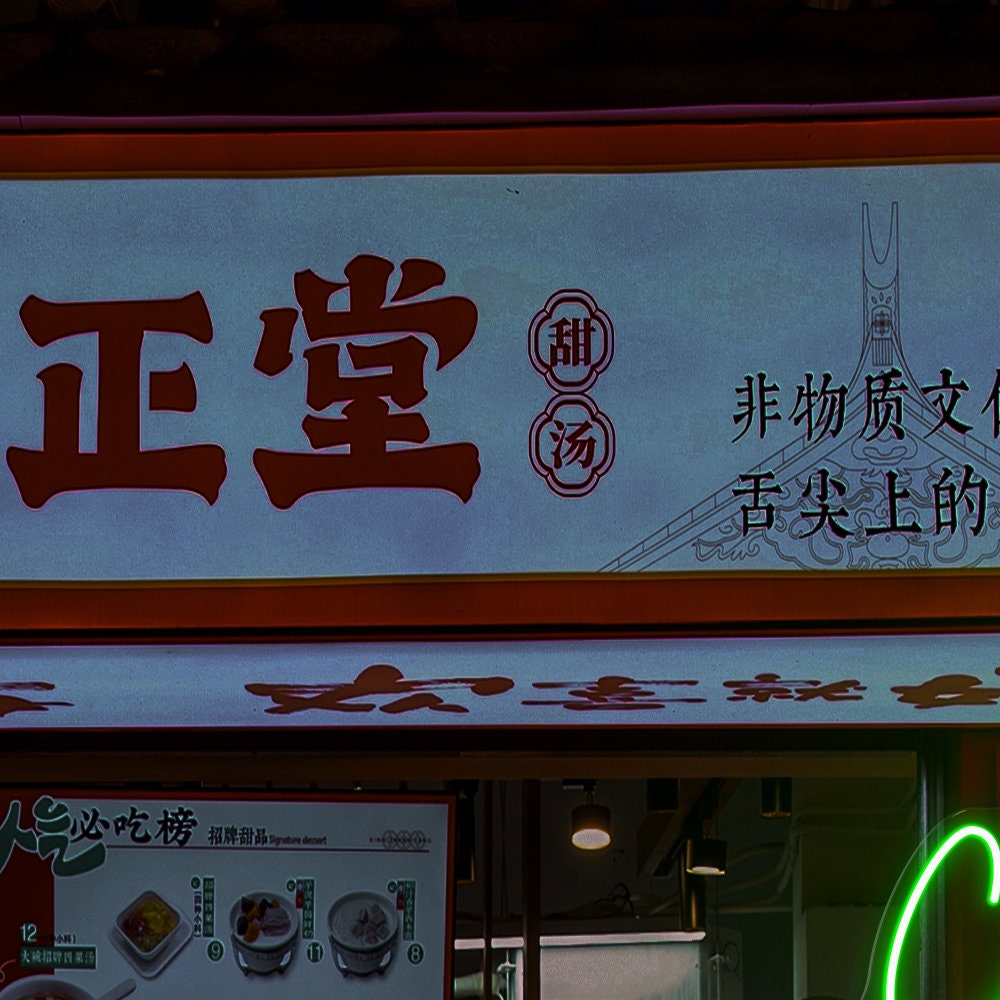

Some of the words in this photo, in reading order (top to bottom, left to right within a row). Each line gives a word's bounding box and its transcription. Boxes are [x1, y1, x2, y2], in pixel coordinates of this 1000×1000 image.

[6, 254, 481, 510] 正堂
[70, 807, 198, 847] 必吃榜
[208, 826, 268, 846] 招牌甜品
[21, 924, 38, 942] 12
